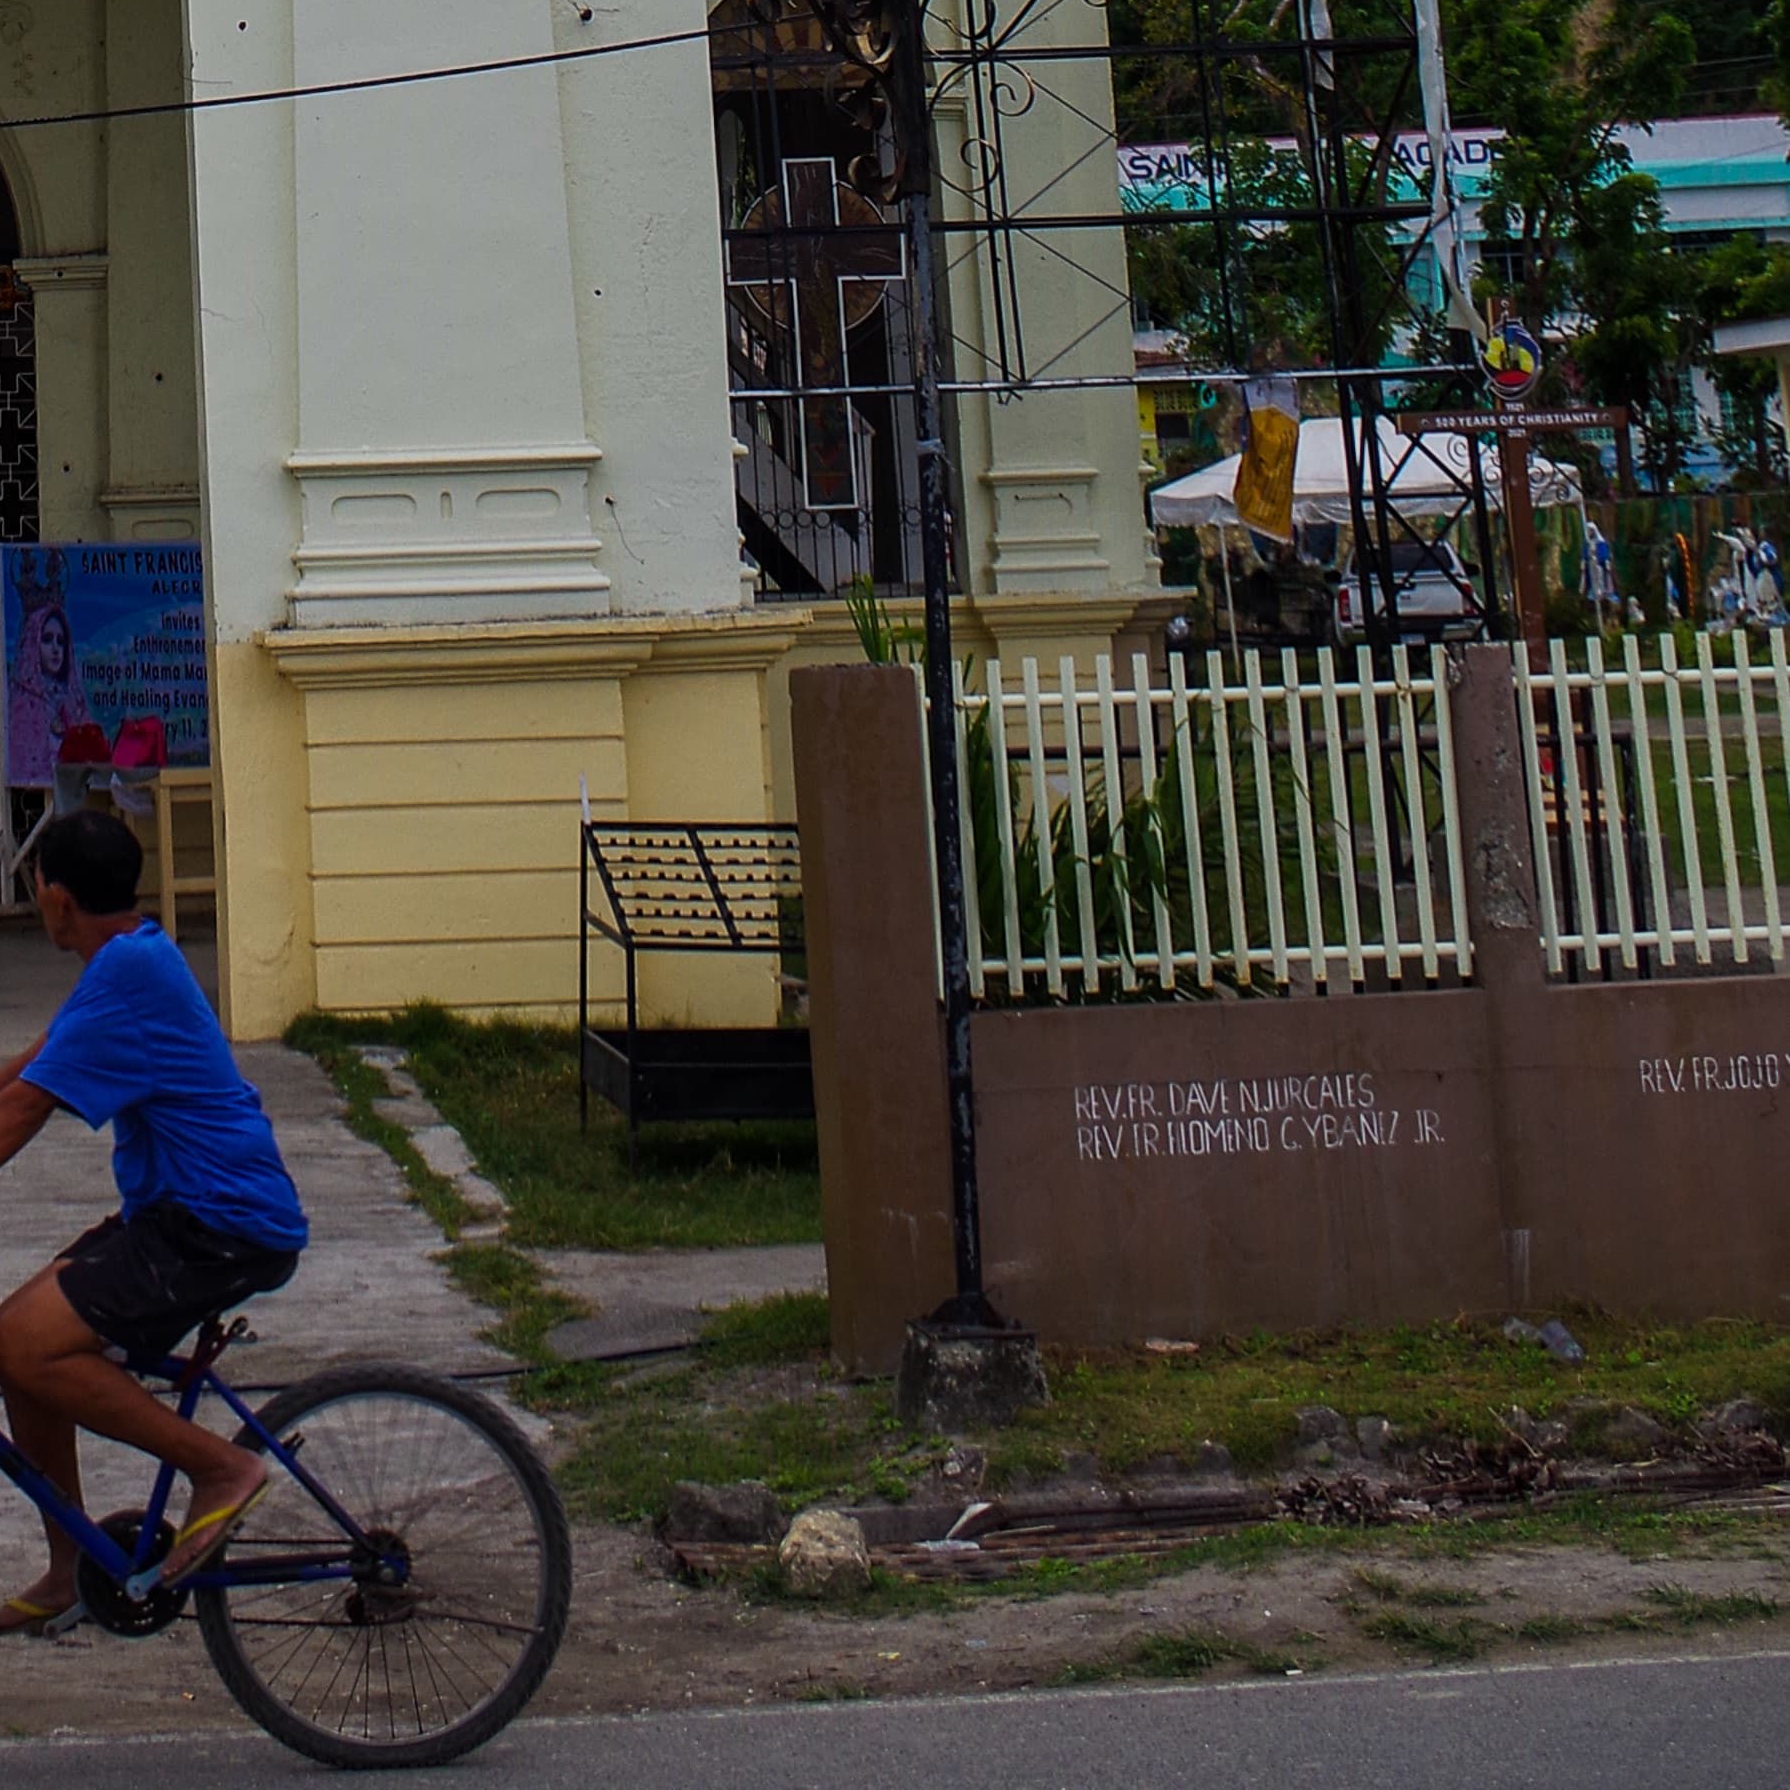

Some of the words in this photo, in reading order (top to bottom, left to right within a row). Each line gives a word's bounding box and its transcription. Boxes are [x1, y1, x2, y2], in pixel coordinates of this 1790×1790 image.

[1435, 416, 1456, 427] 500
[1458, 415, 1497, 427] YEARS
[1499, 414, 1514, 426] OF
[1518, 412, 1598, 426] CHRISTIANITY
[81, 551, 126, 574] SAINT
[81, 661, 121, 685] Image
[125, 661, 137, 679] of
[141, 662, 180, 680] Mama
[93, 688, 117, 707] and
[121, 689, 170, 714] Healing
[174, 690, 209, 709] Evan
[1639, 1057, 1686, 1093] REV.
[1169, 1079, 1229, 1116] DAVE
[1414, 1108, 1446, 1144] JR.
